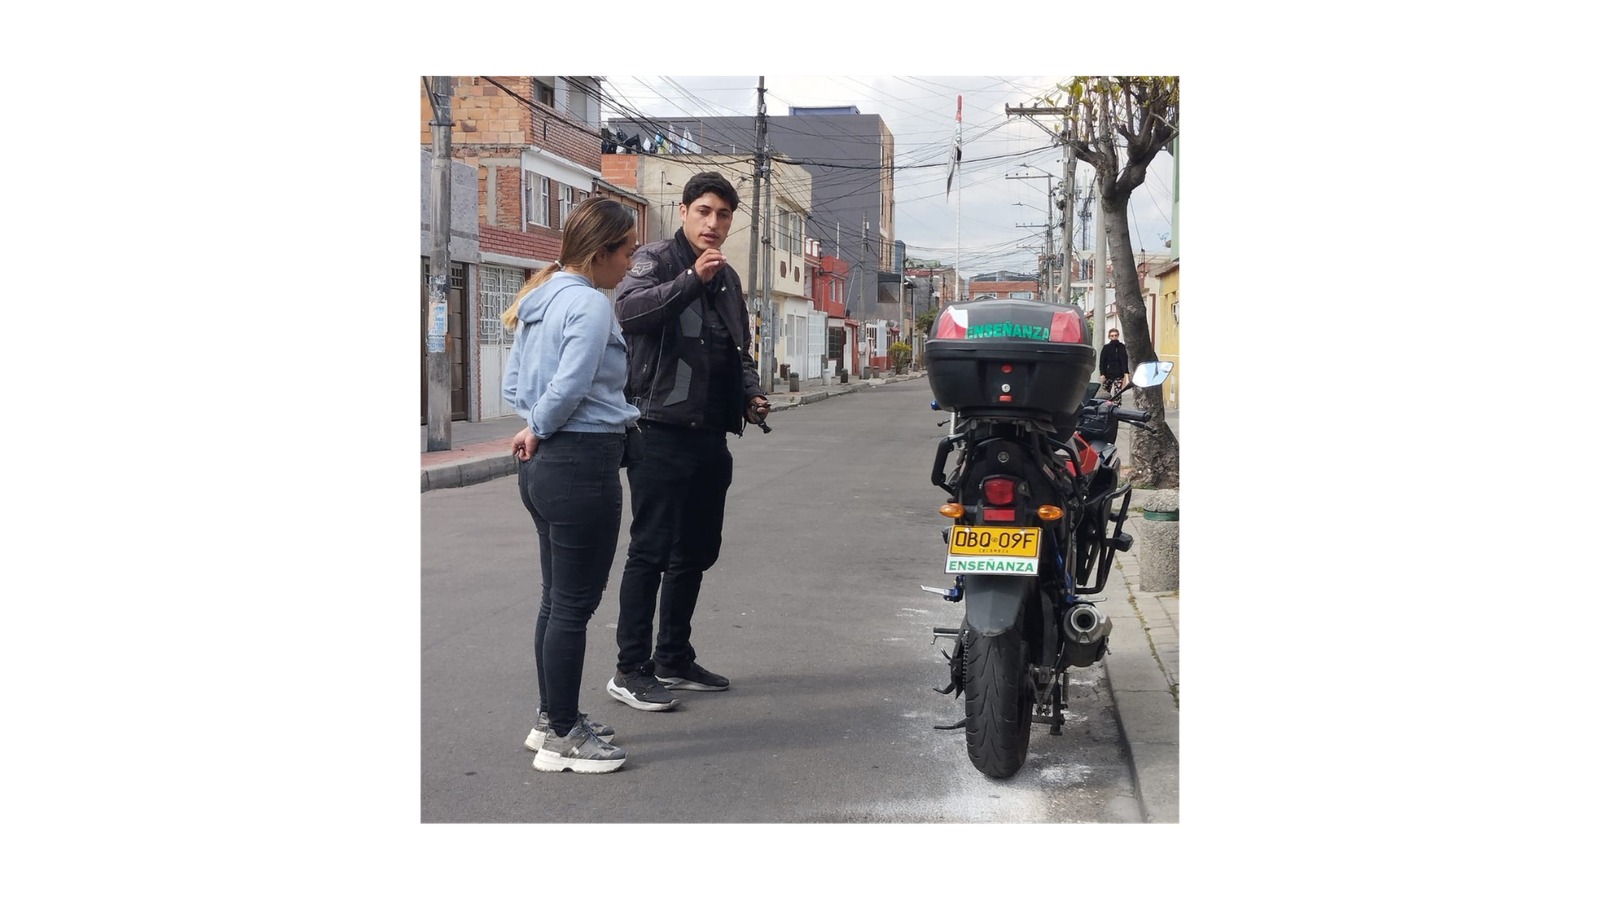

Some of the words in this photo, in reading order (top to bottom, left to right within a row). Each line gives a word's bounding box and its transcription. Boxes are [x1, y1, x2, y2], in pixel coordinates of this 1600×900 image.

[965, 320, 1051, 341] ENSEÑANZA
[999, 532, 1035, 549] 09F
[948, 558, 1034, 572] ENSEÑANZA
